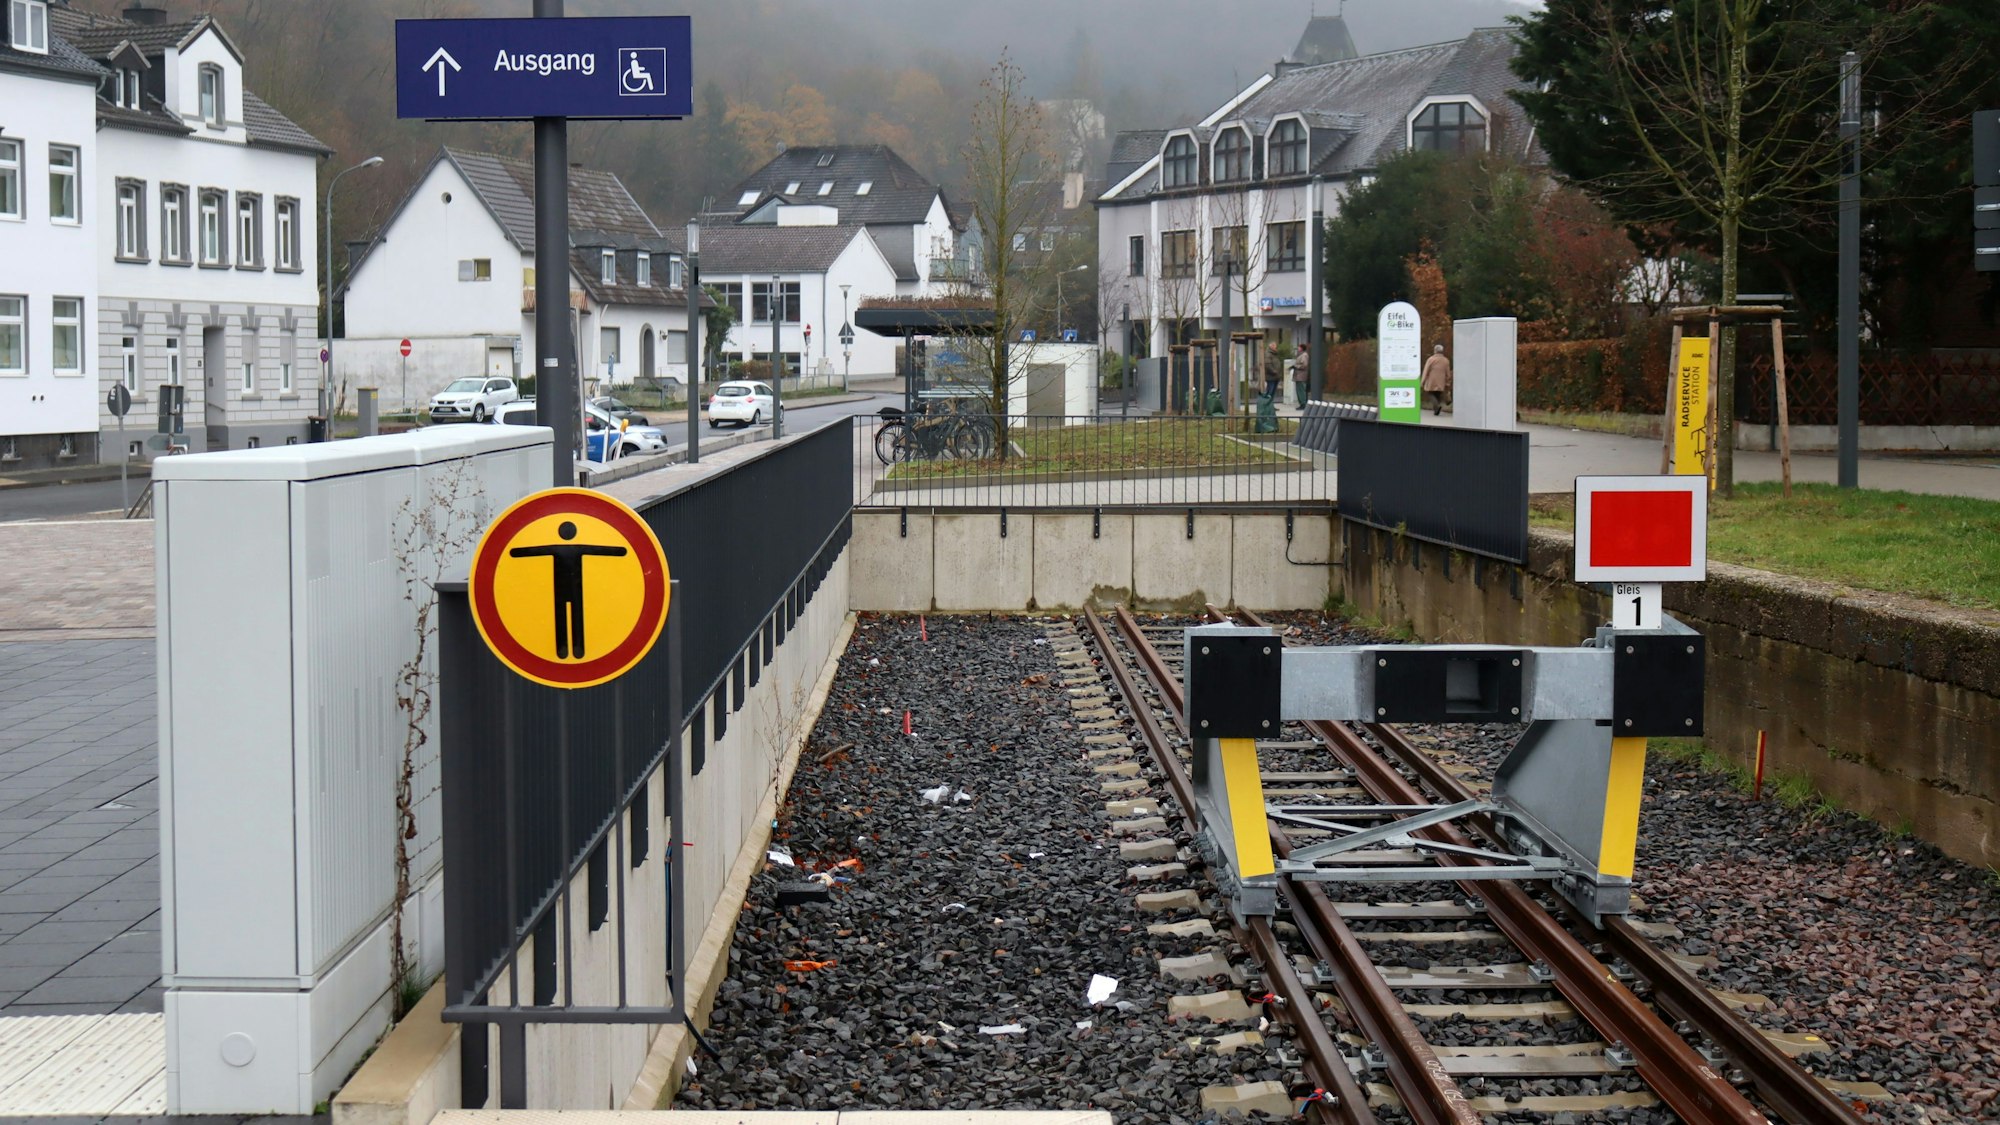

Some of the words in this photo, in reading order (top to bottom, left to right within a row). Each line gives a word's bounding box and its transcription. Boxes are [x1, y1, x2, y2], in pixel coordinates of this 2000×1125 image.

[494, 49, 596, 76] Ausgang
[1387, 312, 1406, 321] Eifel
[1681, 366, 1691, 428] RADSERVICE
[1691, 366, 1701, 405] STATION
[1616, 584, 1641, 595] Gleis
[1631, 596, 1642, 626] 1
